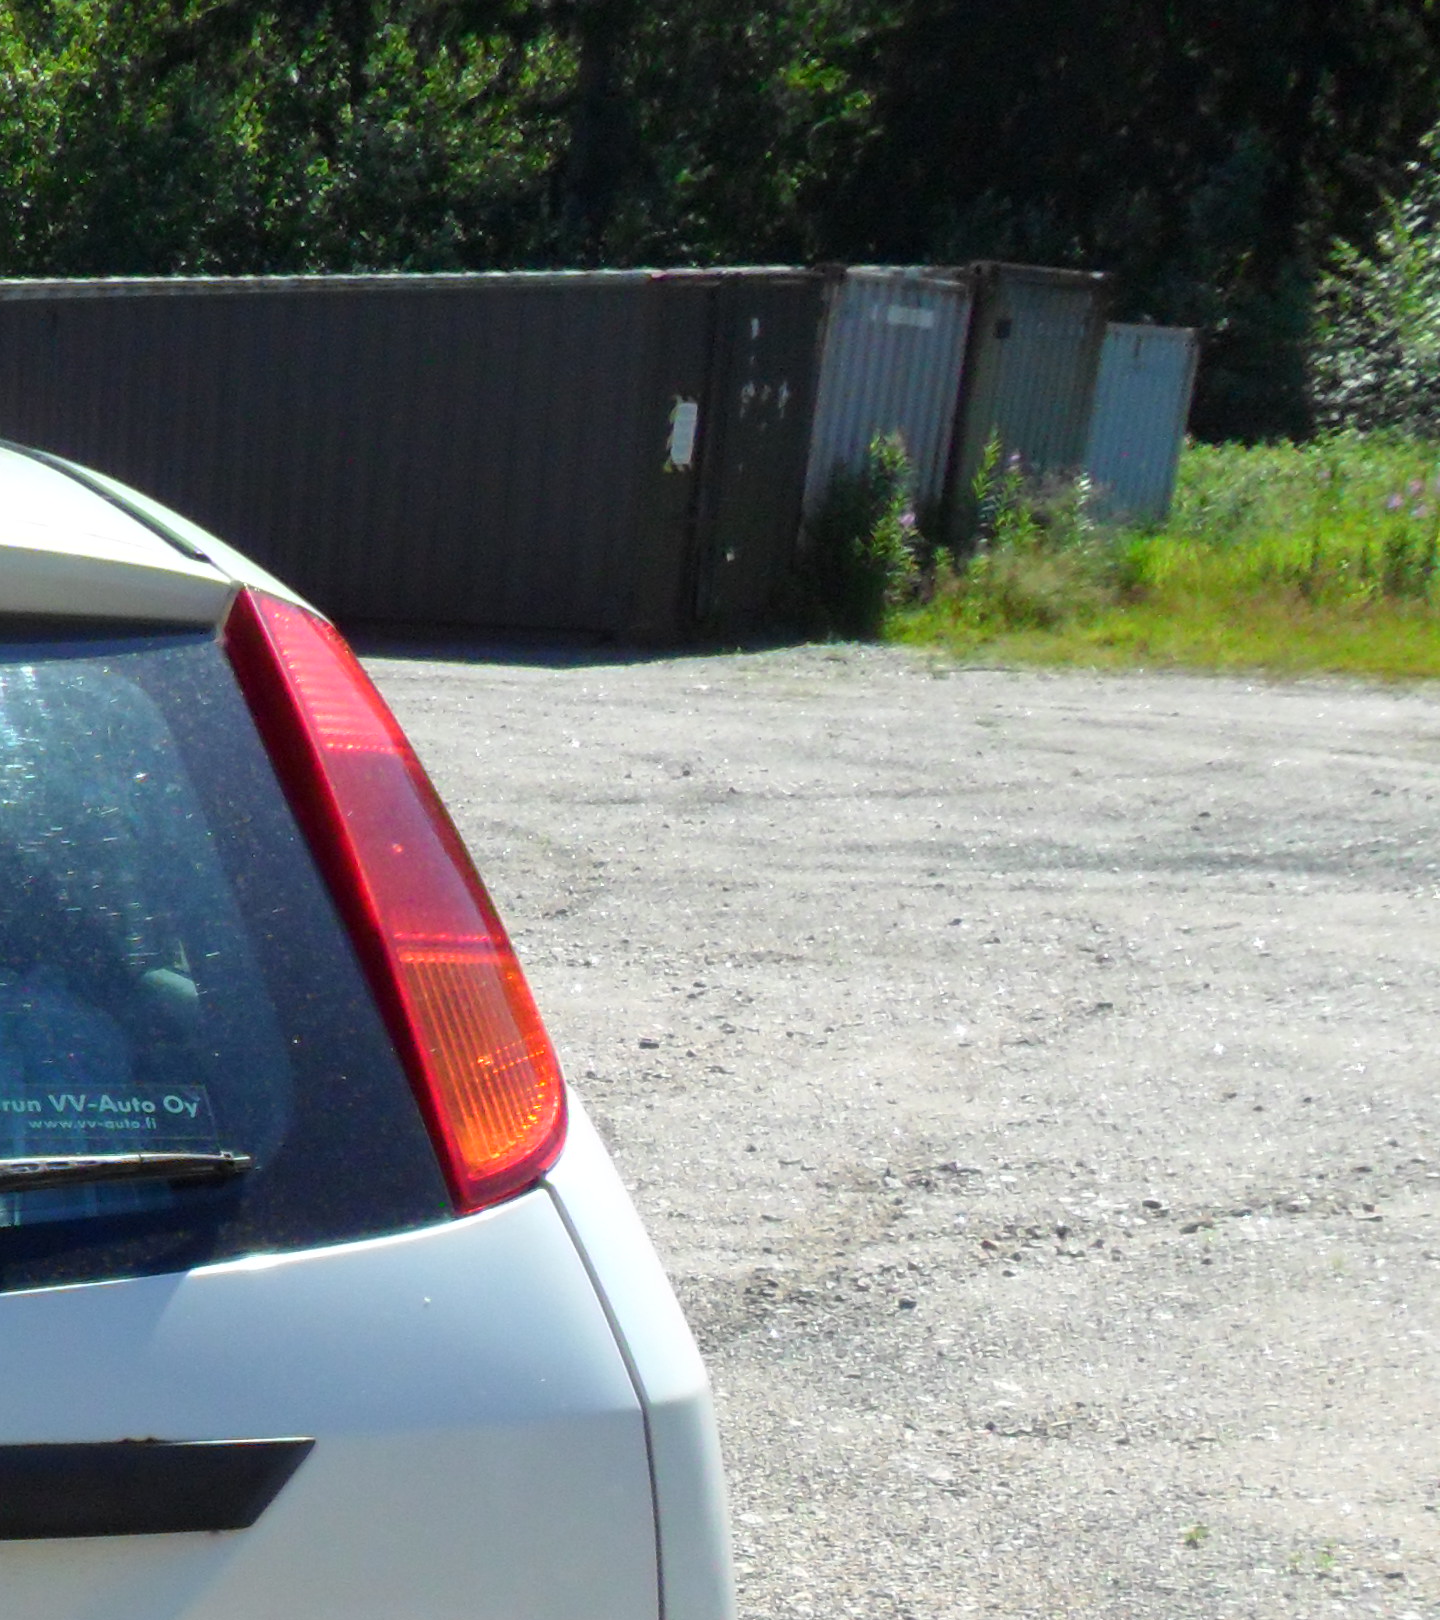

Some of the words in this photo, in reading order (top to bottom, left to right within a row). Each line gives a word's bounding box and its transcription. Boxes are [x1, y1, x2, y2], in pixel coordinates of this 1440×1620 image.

[48, 1094, 156, 1114] VV-Auto
[163, 1094, 201, 1118] Oy
[28, 1116, 158, 1131] www.vv-auto.fi
